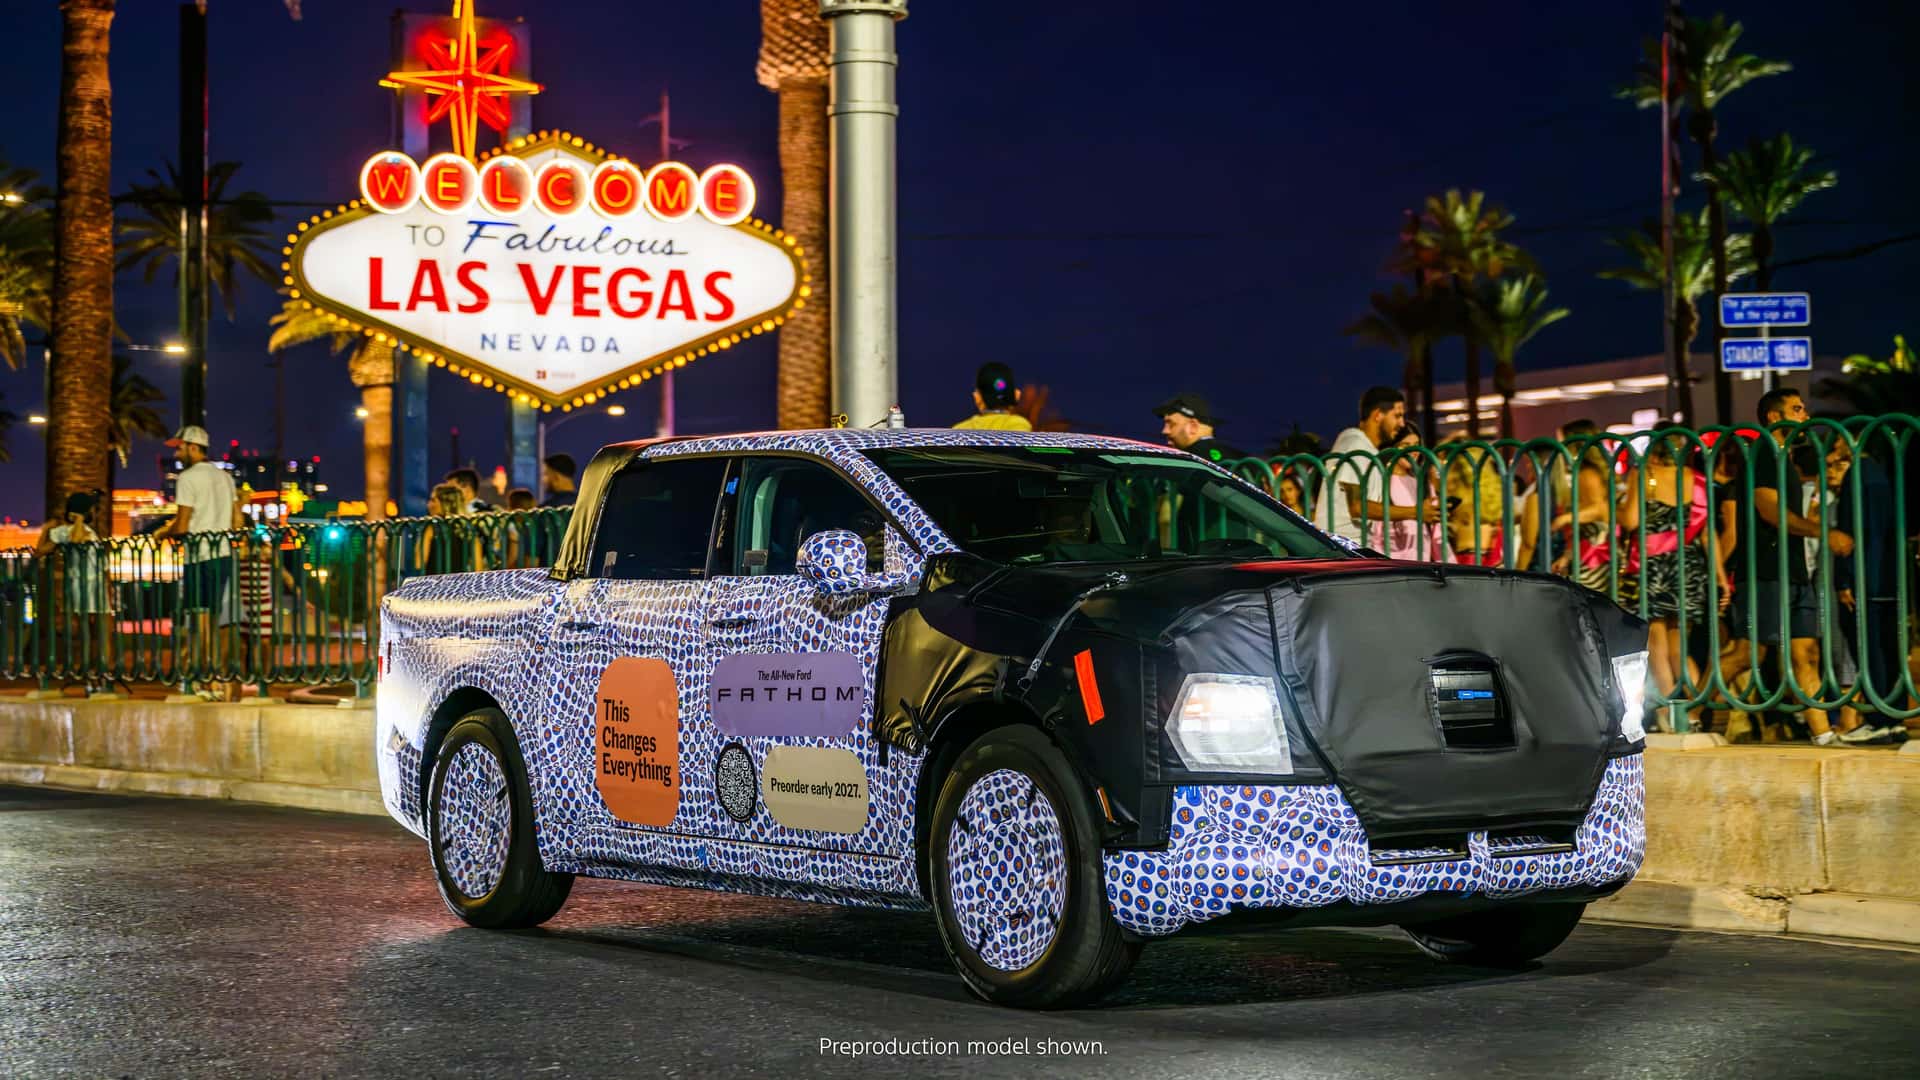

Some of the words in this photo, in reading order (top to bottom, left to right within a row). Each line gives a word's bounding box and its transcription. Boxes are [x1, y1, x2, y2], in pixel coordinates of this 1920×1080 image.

[373, 167, 738, 213] WELCOME
[407, 224, 446, 248] TO
[462, 220, 689, 257] Fabulous
[368, 256, 489, 315] LAS
[517, 264, 737, 323] VEGAS
[480, 333, 620, 354] NEVADA
[758, 670, 769, 681] The
[770, 670, 795, 680] All-New
[796, 669, 812, 680] Ford
[603, 699, 630, 722] This
[602, 726, 657, 756] Changes
[602, 753, 672, 787] Everything
[771, 777, 810, 794] Preorder
[811, 781, 833, 799] early
[834, 782, 862, 799] 2027.
